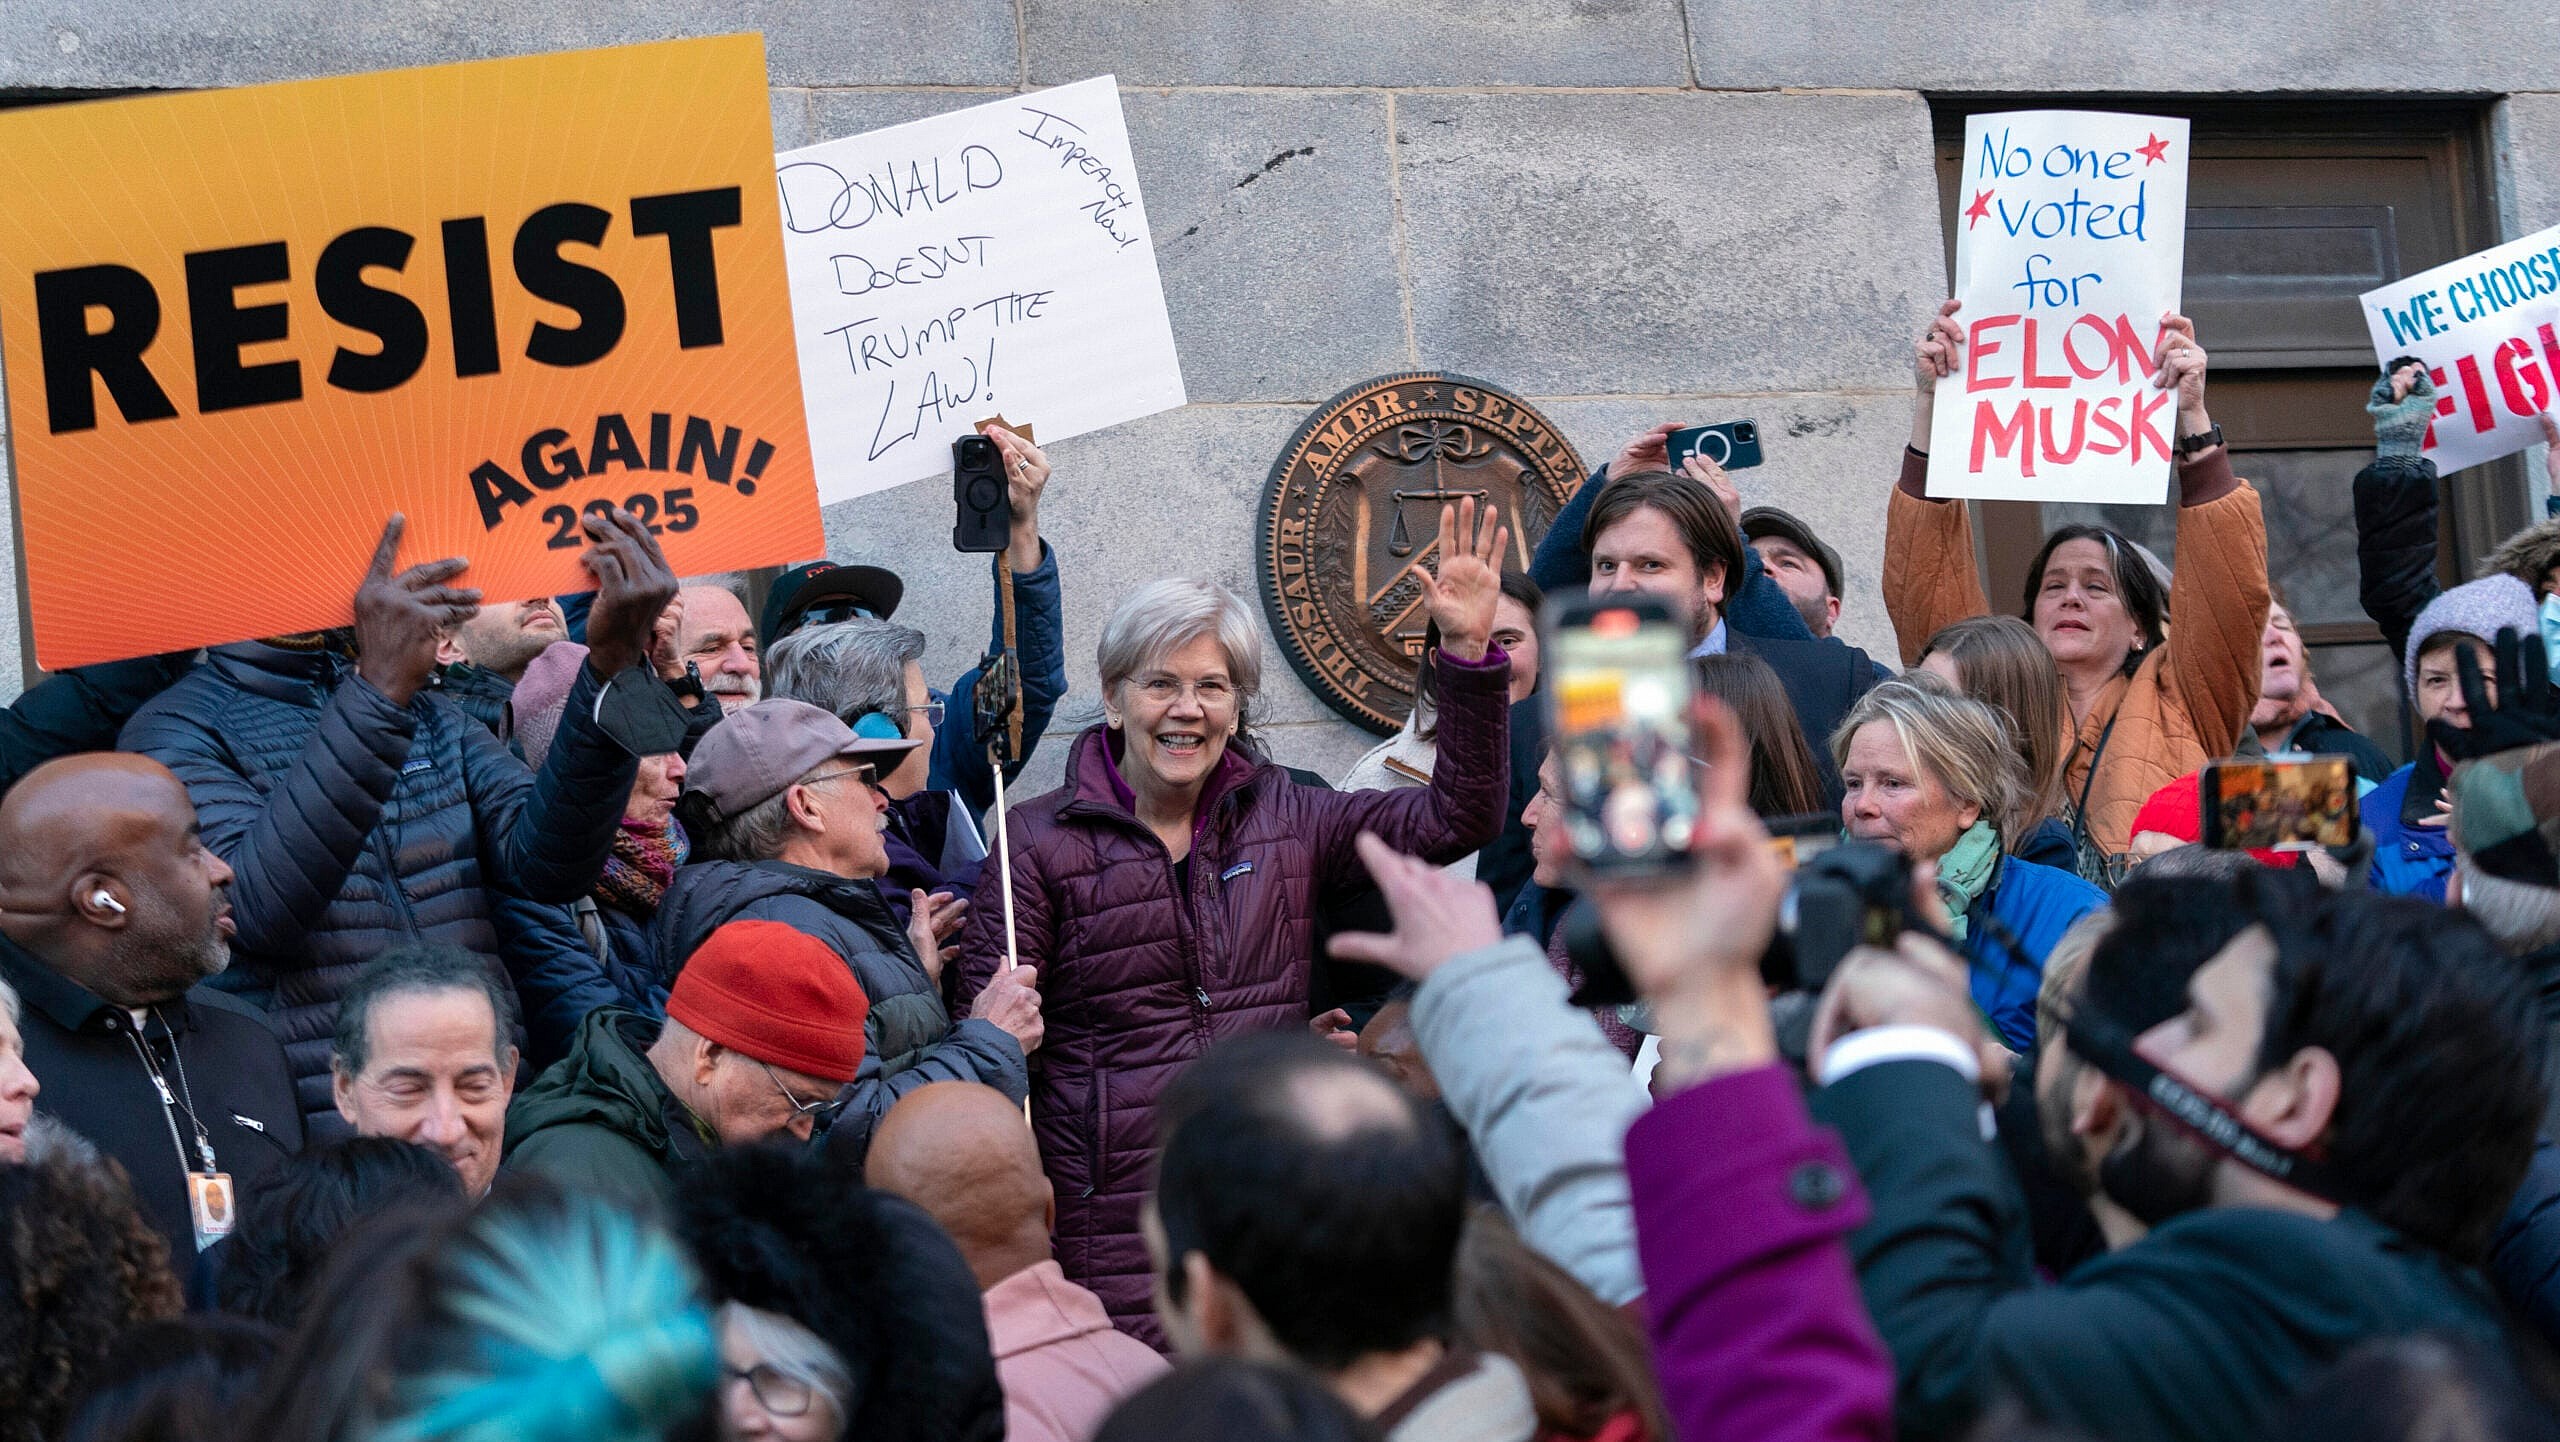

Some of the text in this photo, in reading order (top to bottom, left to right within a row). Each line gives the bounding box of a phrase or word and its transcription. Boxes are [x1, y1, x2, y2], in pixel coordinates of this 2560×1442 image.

[776, 145, 1003, 233] DONALD
[1979, 127, 2136, 180] No one
[1997, 180, 2147, 242] voted
[33, 186, 743, 436] RESIST
[2012, 254, 2103, 309] for
[2381, 289, 2450, 347] WE
[823, 291, 1055, 375] TRUMP THE
[1966, 311, 2171, 394] ELON
[868, 337, 994, 462] LAW!
[1303, 390, 1418, 481] AMER.
[1968, 389, 2174, 478] MUSK
[469, 412, 777, 533] AGAIN!
[1280, 506, 1376, 700] THESAUR.
